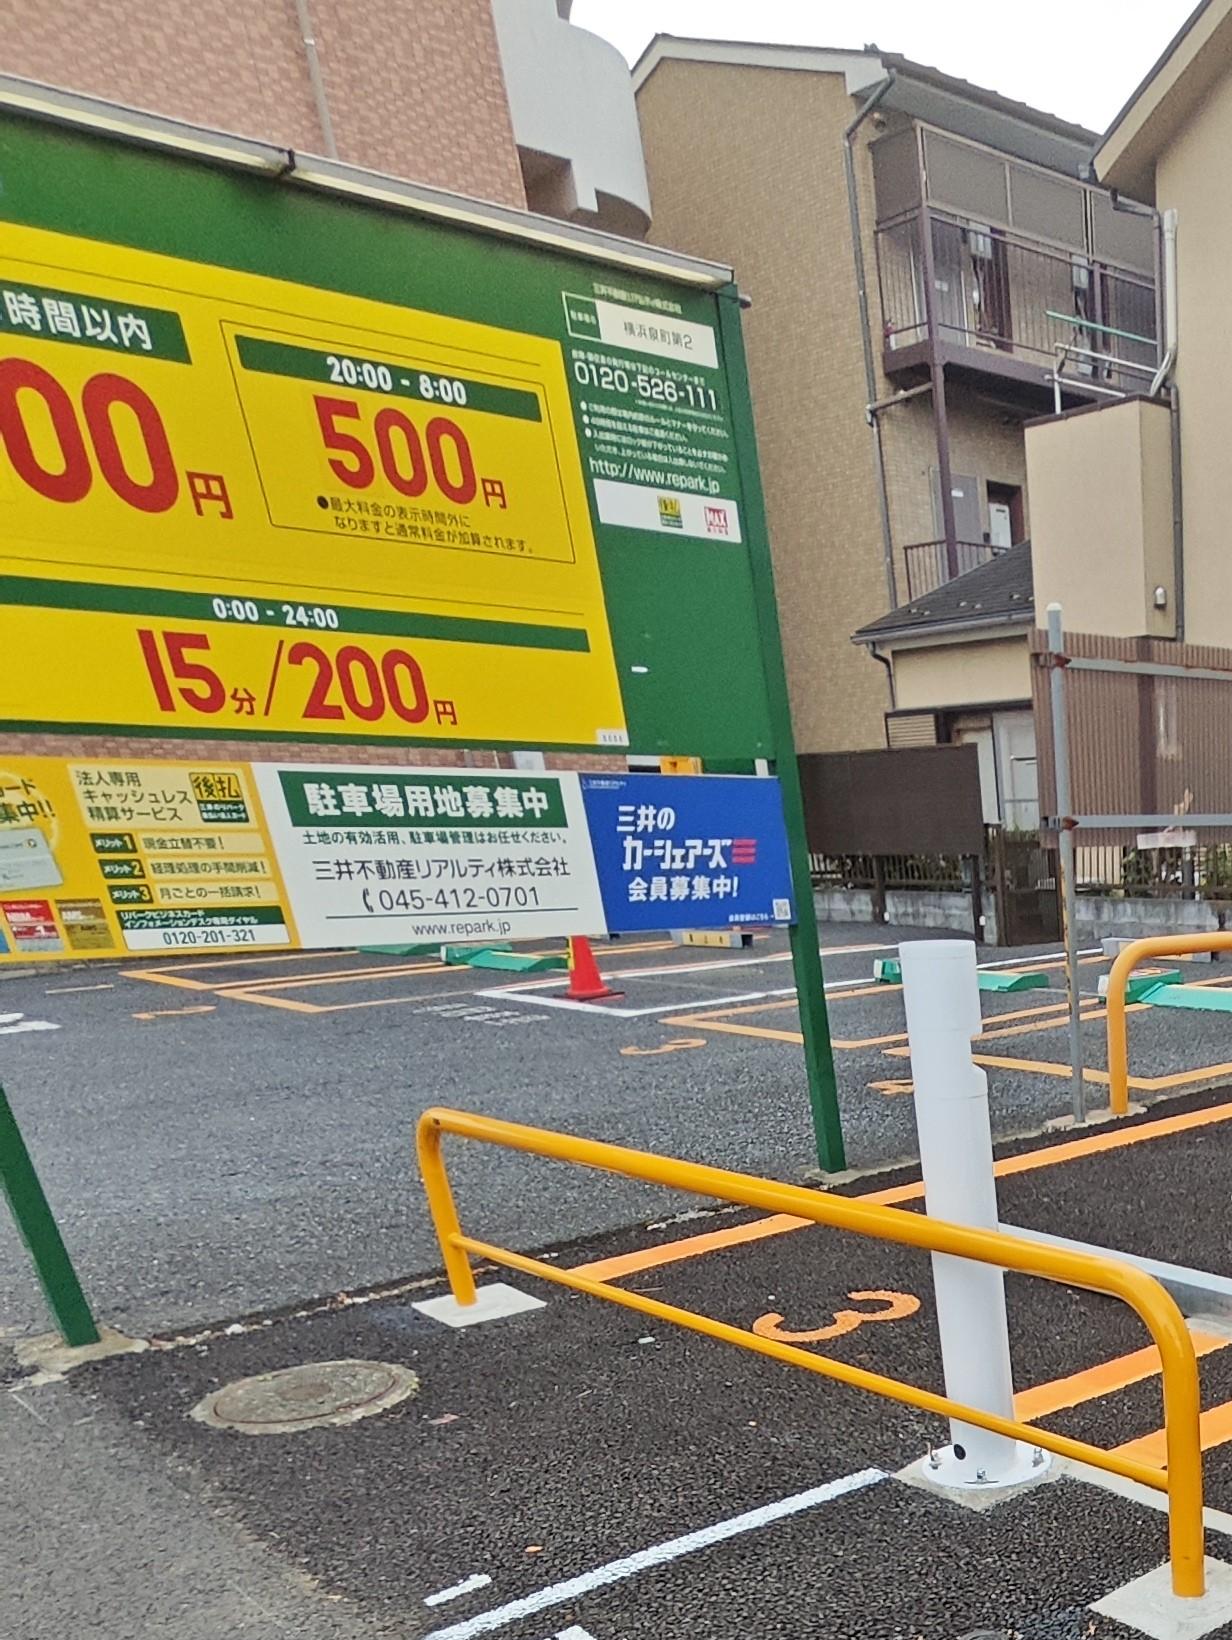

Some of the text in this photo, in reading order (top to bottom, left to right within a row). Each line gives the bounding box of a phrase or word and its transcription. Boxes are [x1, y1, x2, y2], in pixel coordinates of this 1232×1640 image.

[0, 290, 153, 350] 時間以内
[326, 356, 392, 391] 20:00
[419, 374, 467, 405] 8:00
[574, 361, 716, 410] 0120-526-111
[313, 395, 507, 509] 500円
[589, 457, 719, 494] http://www.repark.jp
[330, 497, 471, 527] 最大料金の表示時間外に
[334, 515, 533, 554] なりますと通常料金が加算されます。
[212, 599, 258, 622] 0:00
[282, 605, 339, 629] 24:00
[0, 778, 36, 798] ード
[76, 770, 141, 788] 法人専用
[192, 776, 241, 798] 後払
[84, 789, 192, 804] キャッシュレス
[303, 782, 548, 819] 駐車場用地募集中
[87, 806, 183, 821] 精算サービス
[617, 805, 675, 832] 三井の
[303, 831, 567, 845] 土地の有効活用、駐車場管理はお任せください。
[312, 857, 571, 880] 三井不動産リアルティ株式会社
[379, 886, 541, 911] 045-412-0701
[163, 929, 255, 946] 0120-201-321
[412, 919, 511, 937] www.repark.jp
